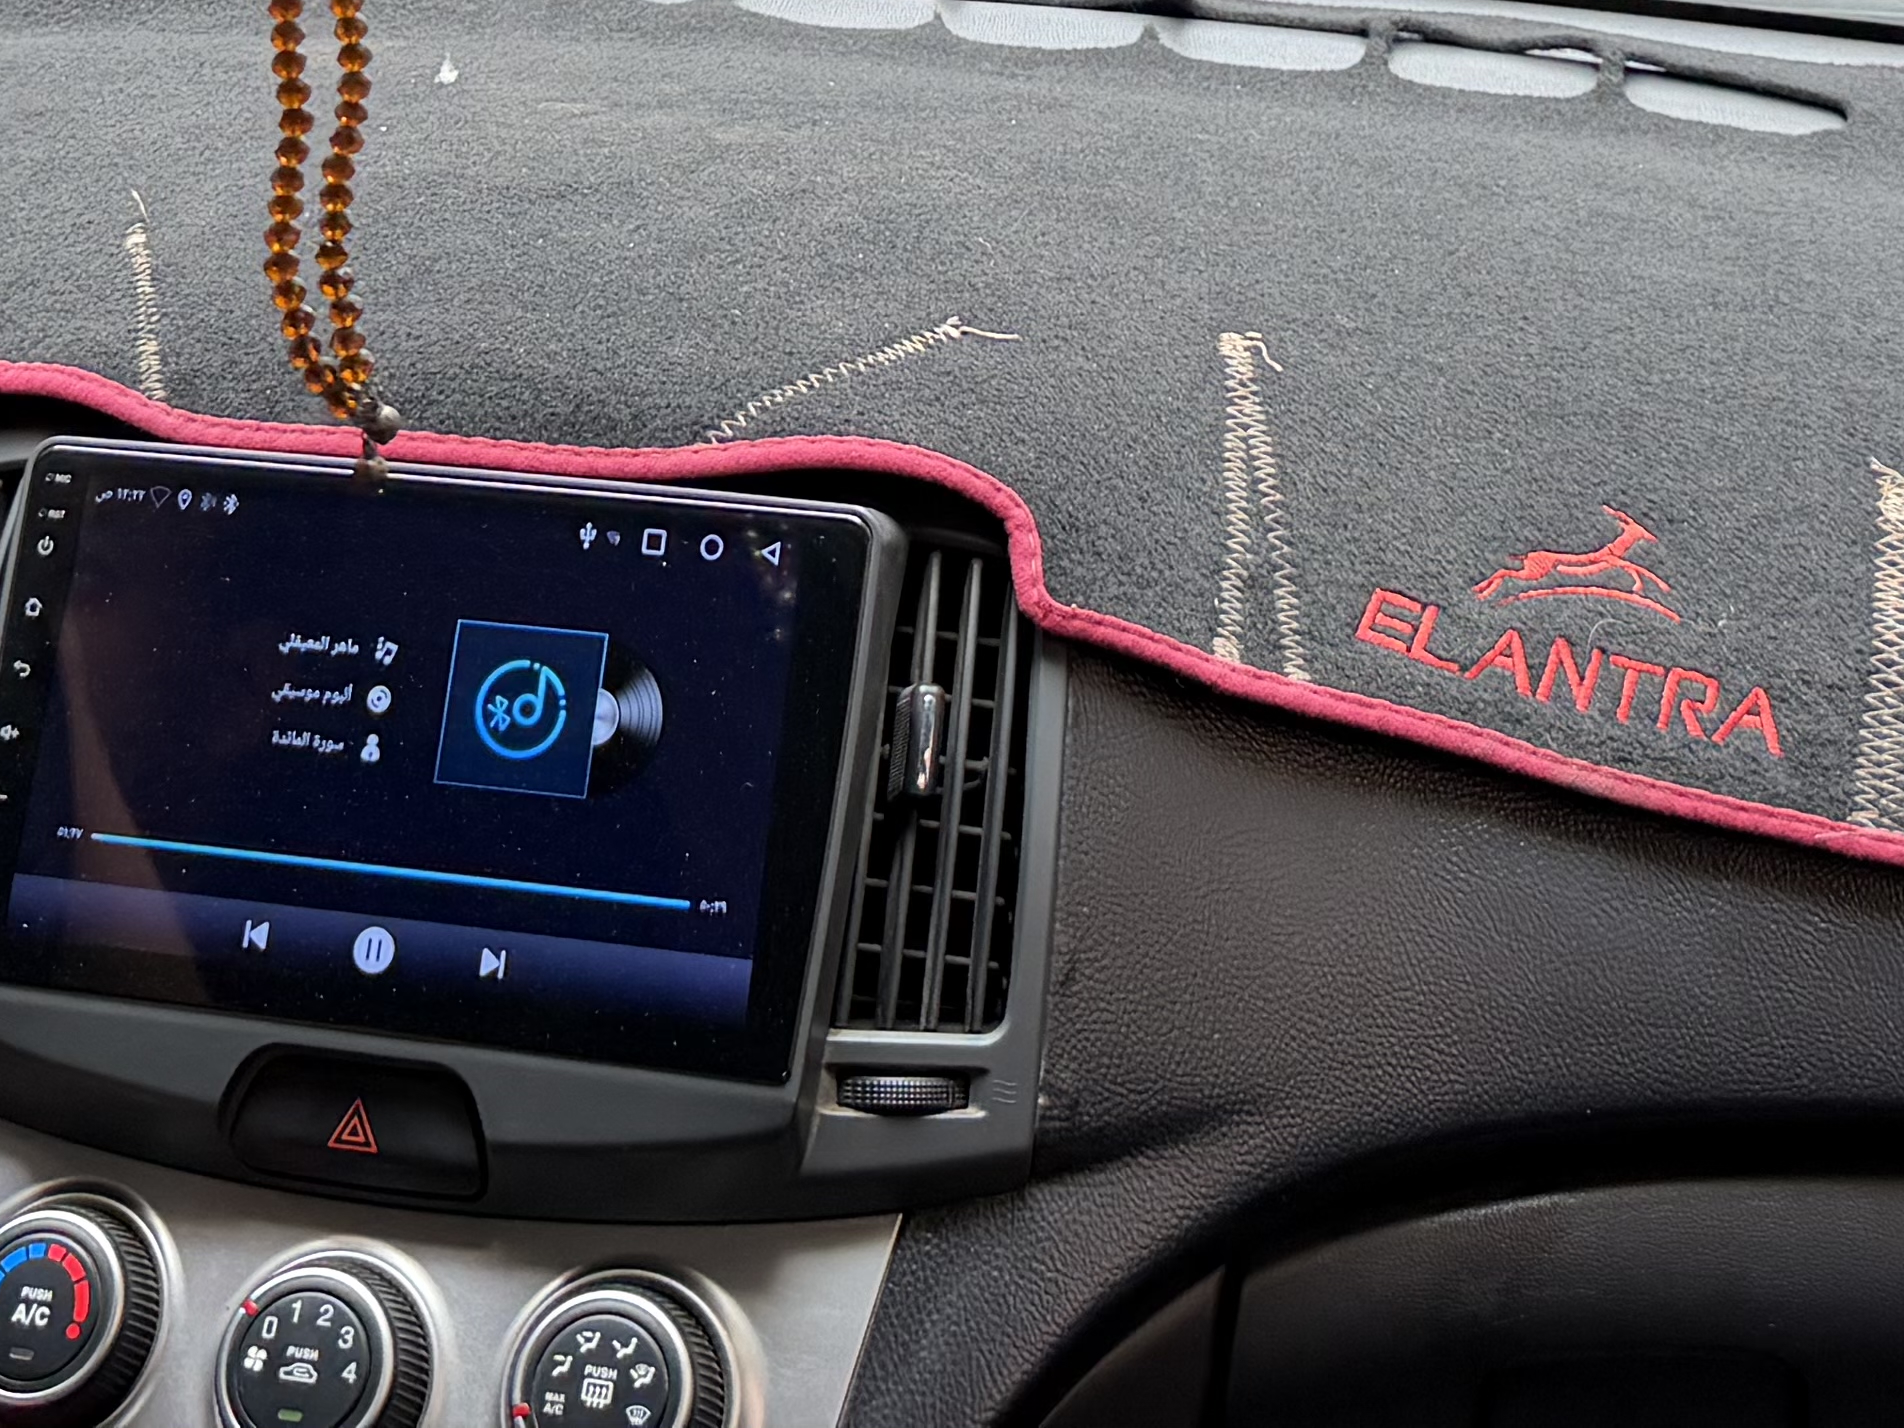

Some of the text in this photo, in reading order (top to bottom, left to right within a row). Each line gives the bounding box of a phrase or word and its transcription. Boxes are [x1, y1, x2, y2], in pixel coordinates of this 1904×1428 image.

[330, 638, 360, 657] ماهر
[1353, 586, 1786, 758] ELANTRA
[312, 733, 345, 754] سورة
[20, 1285, 53, 1303] PUSH
[11, 1302, 51, 1328] A/C
[261, 1299, 358, 1384] 0 1 2 3 4
[286, 1345, 320, 1362] PUSH
[583, 1363, 619, 1381] PUSH
[544, 1391, 566, 1403] MAX
[542, 1403, 565, 1416] A/C
